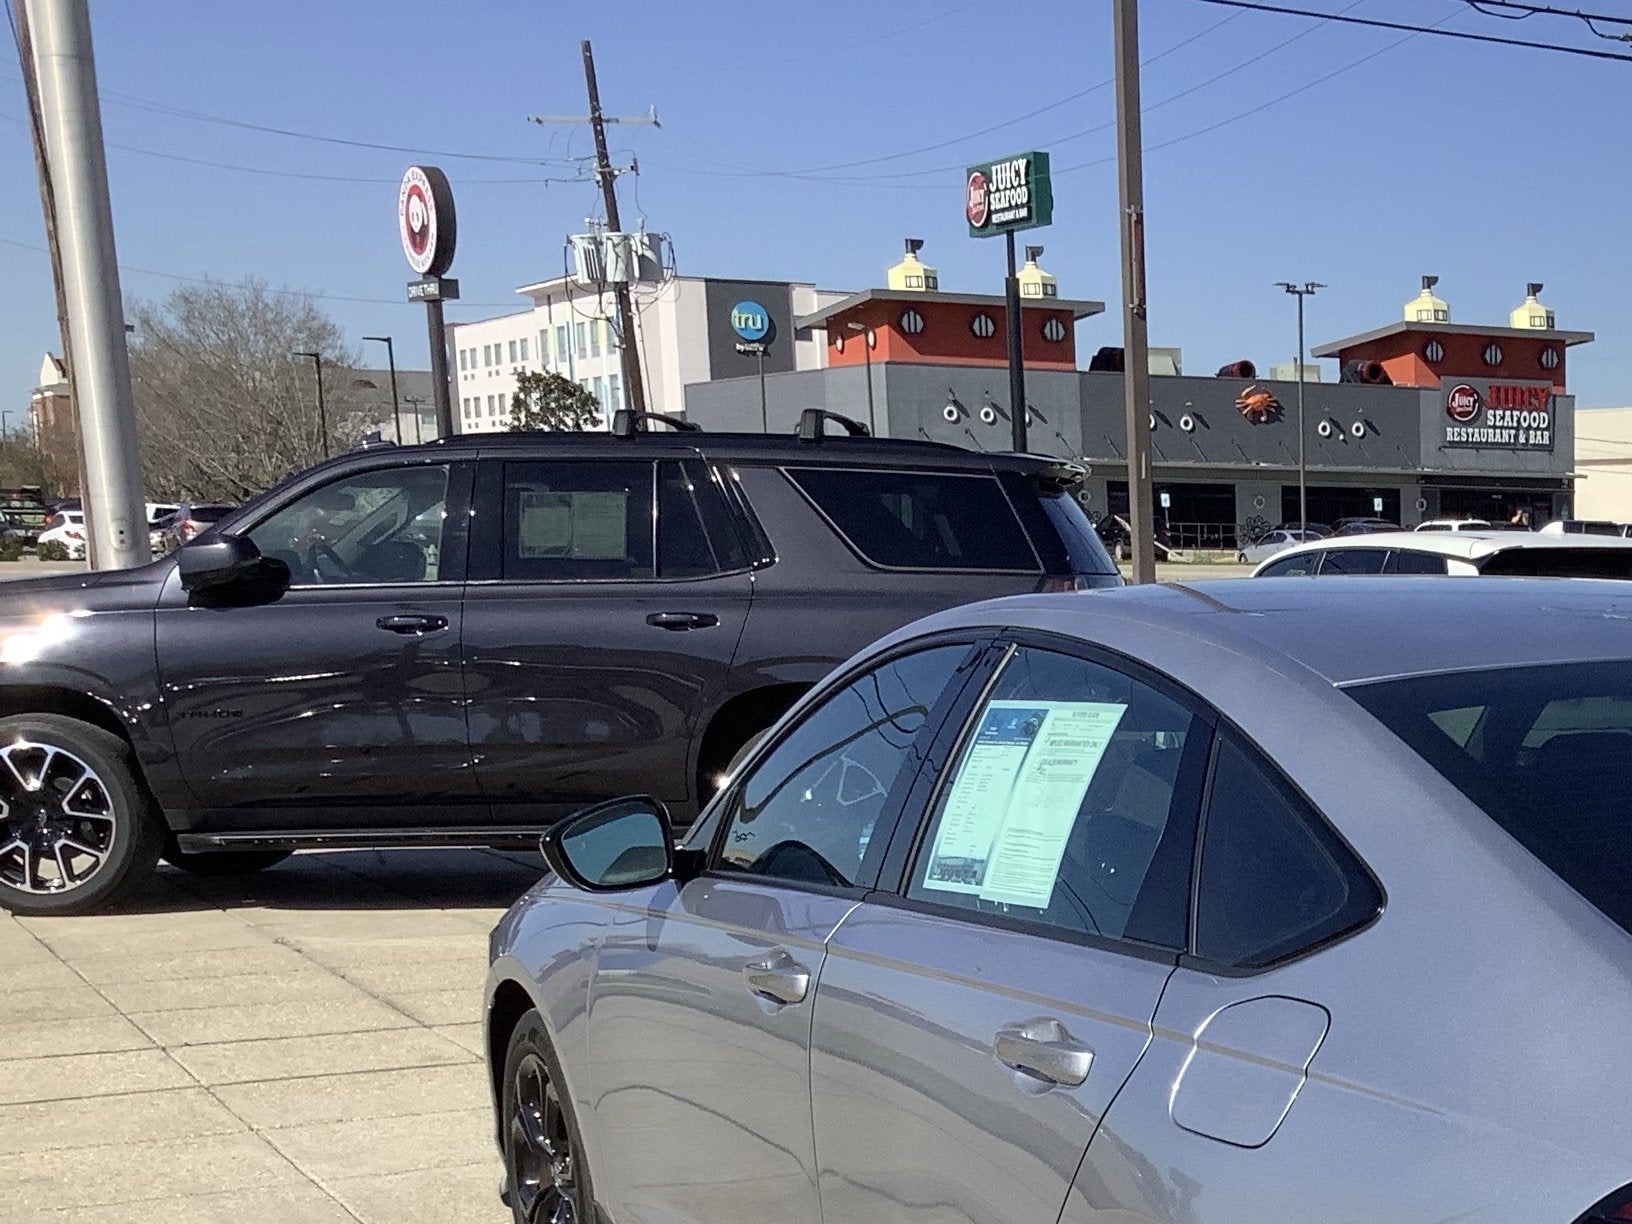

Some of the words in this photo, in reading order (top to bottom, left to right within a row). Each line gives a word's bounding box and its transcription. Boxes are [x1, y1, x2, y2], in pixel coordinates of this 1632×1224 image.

[989, 158, 1027, 192] JUICY
[990, 186, 1028, 211] SEAFOOD
[1484, 384, 1549, 410] JUICY
[1487, 409, 1549, 428] SEAFOOD
[1446, 427, 1516, 443] RESTAURANT
[1519, 429, 1526, 443] &
[1529, 430, 1550, 444] BAR
